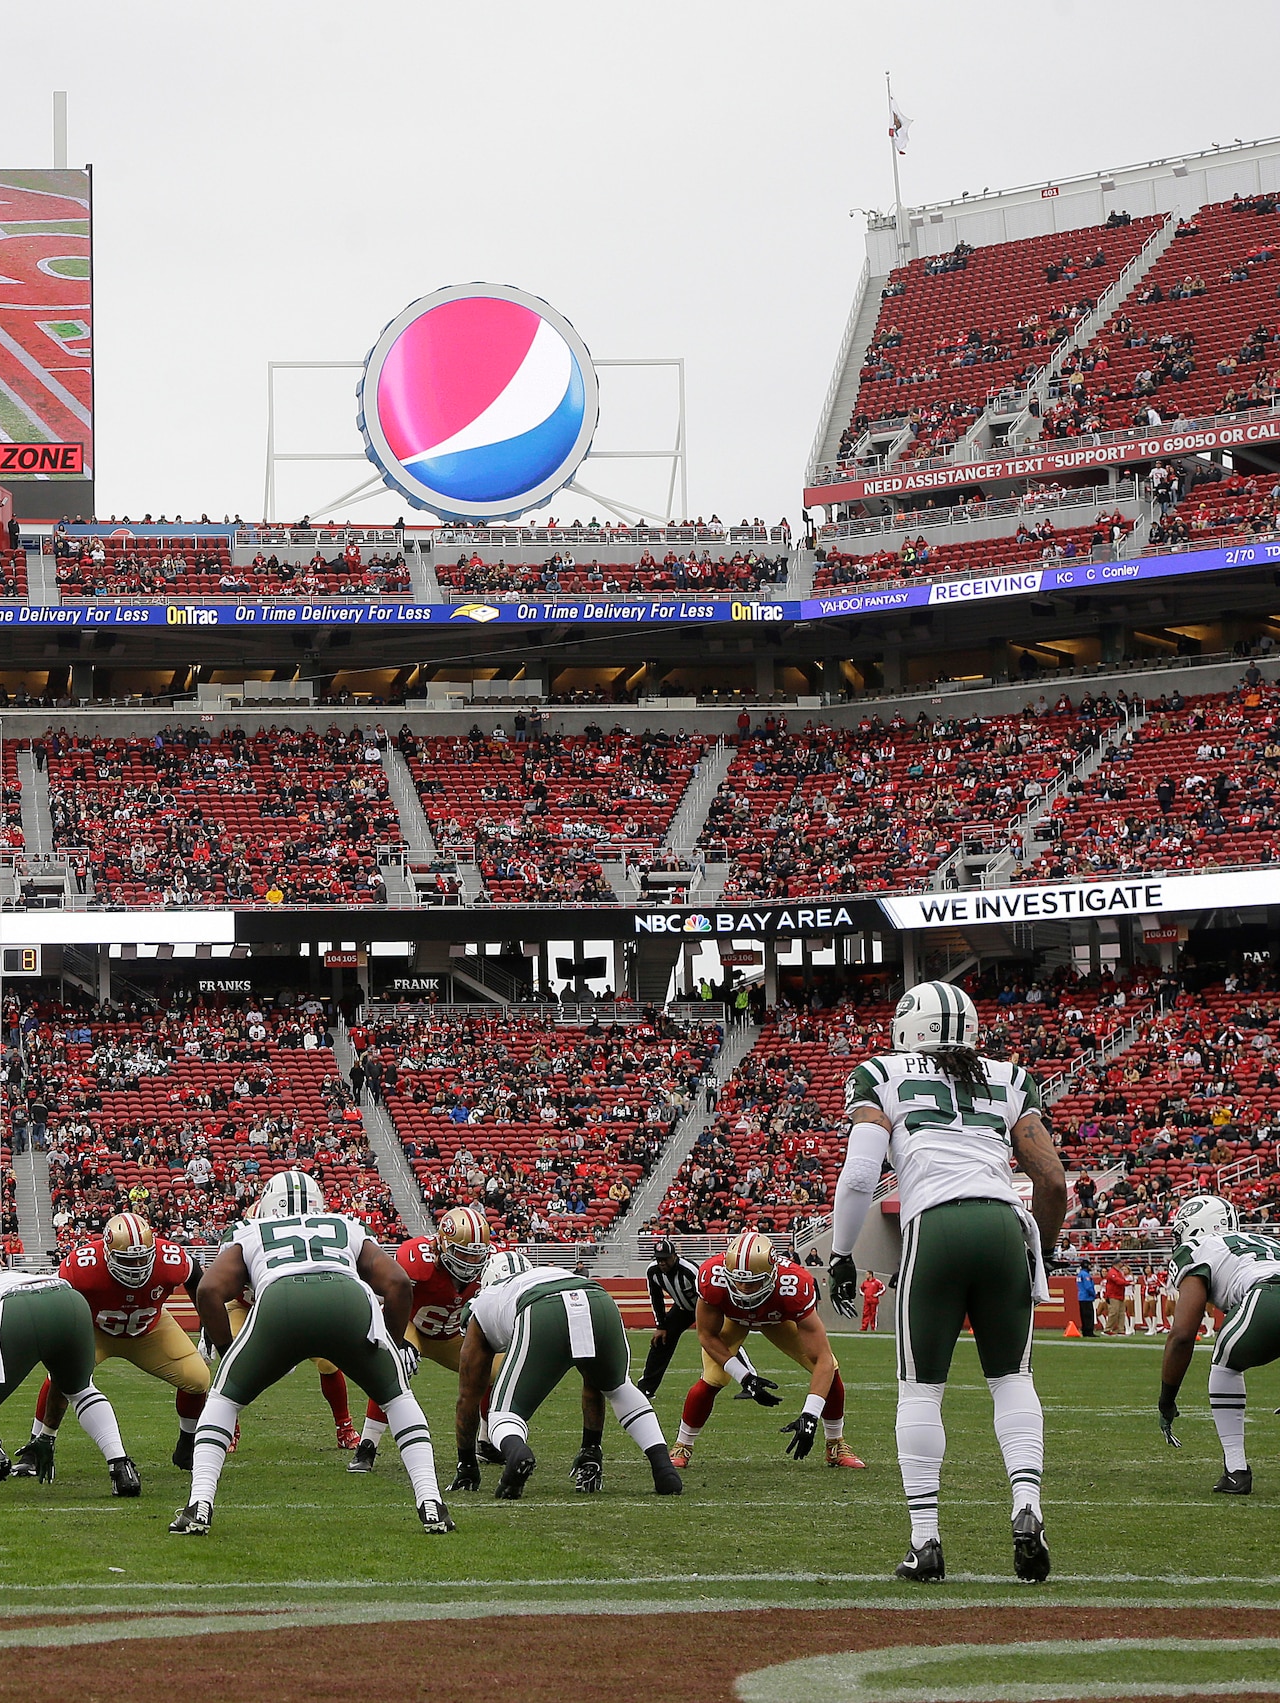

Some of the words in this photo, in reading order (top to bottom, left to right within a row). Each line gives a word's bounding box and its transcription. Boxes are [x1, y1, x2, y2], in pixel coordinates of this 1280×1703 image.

[1043, 188, 1058, 198] 401
[0, 448, 76, 469] ZONE
[864, 479, 902, 495] NEED
[906, 462, 1003, 491] ASSISTANCE?
[1005, 457, 1044, 475] TEXT
[1139, 439, 1159, 456] TO
[1163, 431, 1217, 453] 69050
[1220, 428, 1244, 444] OR
[1246, 423, 1280, 440] CAL
[1226, 549, 1255, 564] 2/70
[1056, 571, 1074, 584] KC
[1086, 569, 1096, 580] C
[1102, 564, 1139, 581] Conley
[935, 575, 1037, 601] RECEIVING
[517, 603, 539, 619] On
[543, 603, 579, 619] Time
[583, 603, 644, 622] Delivery
[649, 603, 675, 619] For
[680, 603, 714, 619] Less
[732, 601, 783, 621] OnTrac
[820, 597, 864, 614] YAHOO!
[865, 592, 908, 607] FANTASY
[18, 607, 81, 625] Delivery
[86, 607, 112, 622] For
[116, 607, 149, 622] Less
[166, 606, 218, 624] OnTrac
[235, 606, 257, 621] On
[261, 606, 299, 621] Time
[304, 606, 364, 624] Delivery
[367, 606, 394, 621] For
[398, 606, 432, 621] Less
[920, 898, 968, 923] WE
[975, 885, 1163, 920] INVESTIGATE
[635, 914, 681, 933] NBC
[716, 911, 773, 932] BAY
[776, 907, 853, 930] AREA
[1161, 928, 1177, 938] 107
[326, 955, 341, 964] 104
[342, 955, 357, 964] 105
[199, 980, 252, 992] FRANKS
[394, 978, 440, 990] FRANK
[929, 1023, 940, 1032] 90
[258, 1217, 351, 1269] 52
[75, 1247, 97, 1267] 66
[163, 1244, 182, 1266] 66
[779, 1274, 799, 1296] 89
[93, 1307, 158, 1336] 66
